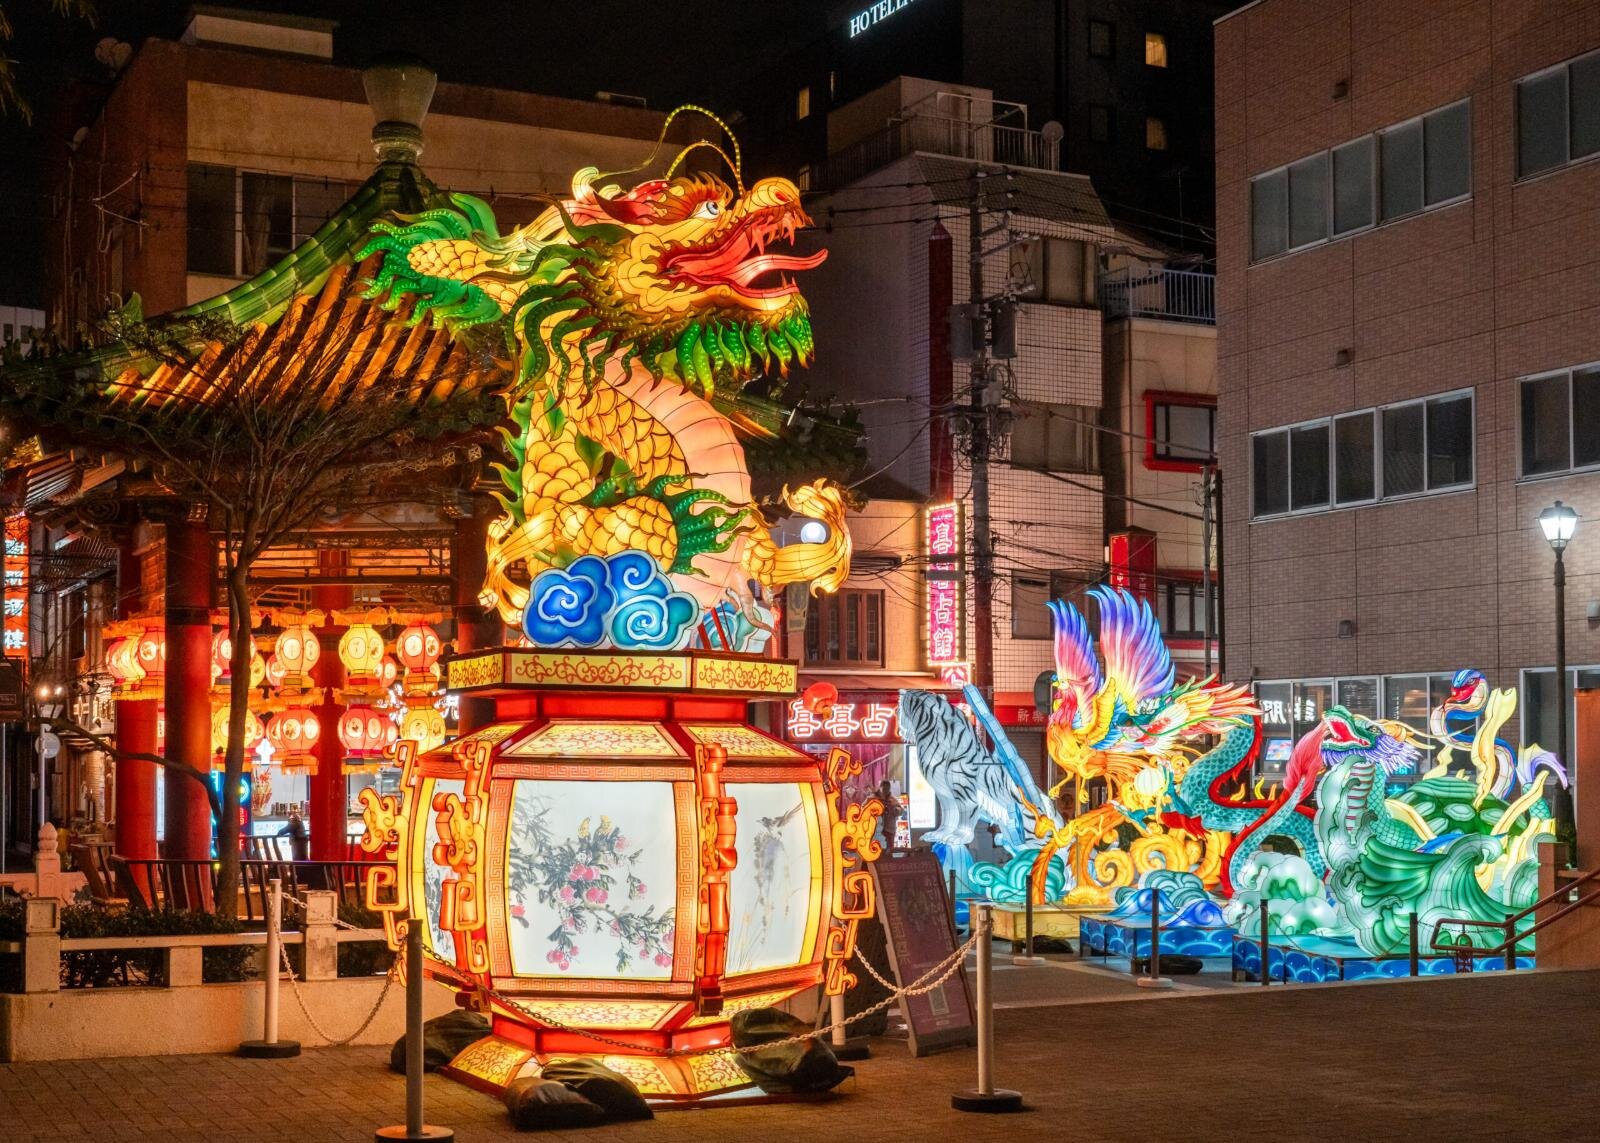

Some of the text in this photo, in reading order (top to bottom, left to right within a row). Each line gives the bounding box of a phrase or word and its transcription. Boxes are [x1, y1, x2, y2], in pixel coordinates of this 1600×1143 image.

[850, 0, 895, 38] HOTEL
[788, 698, 903, 737] 喜喜占
